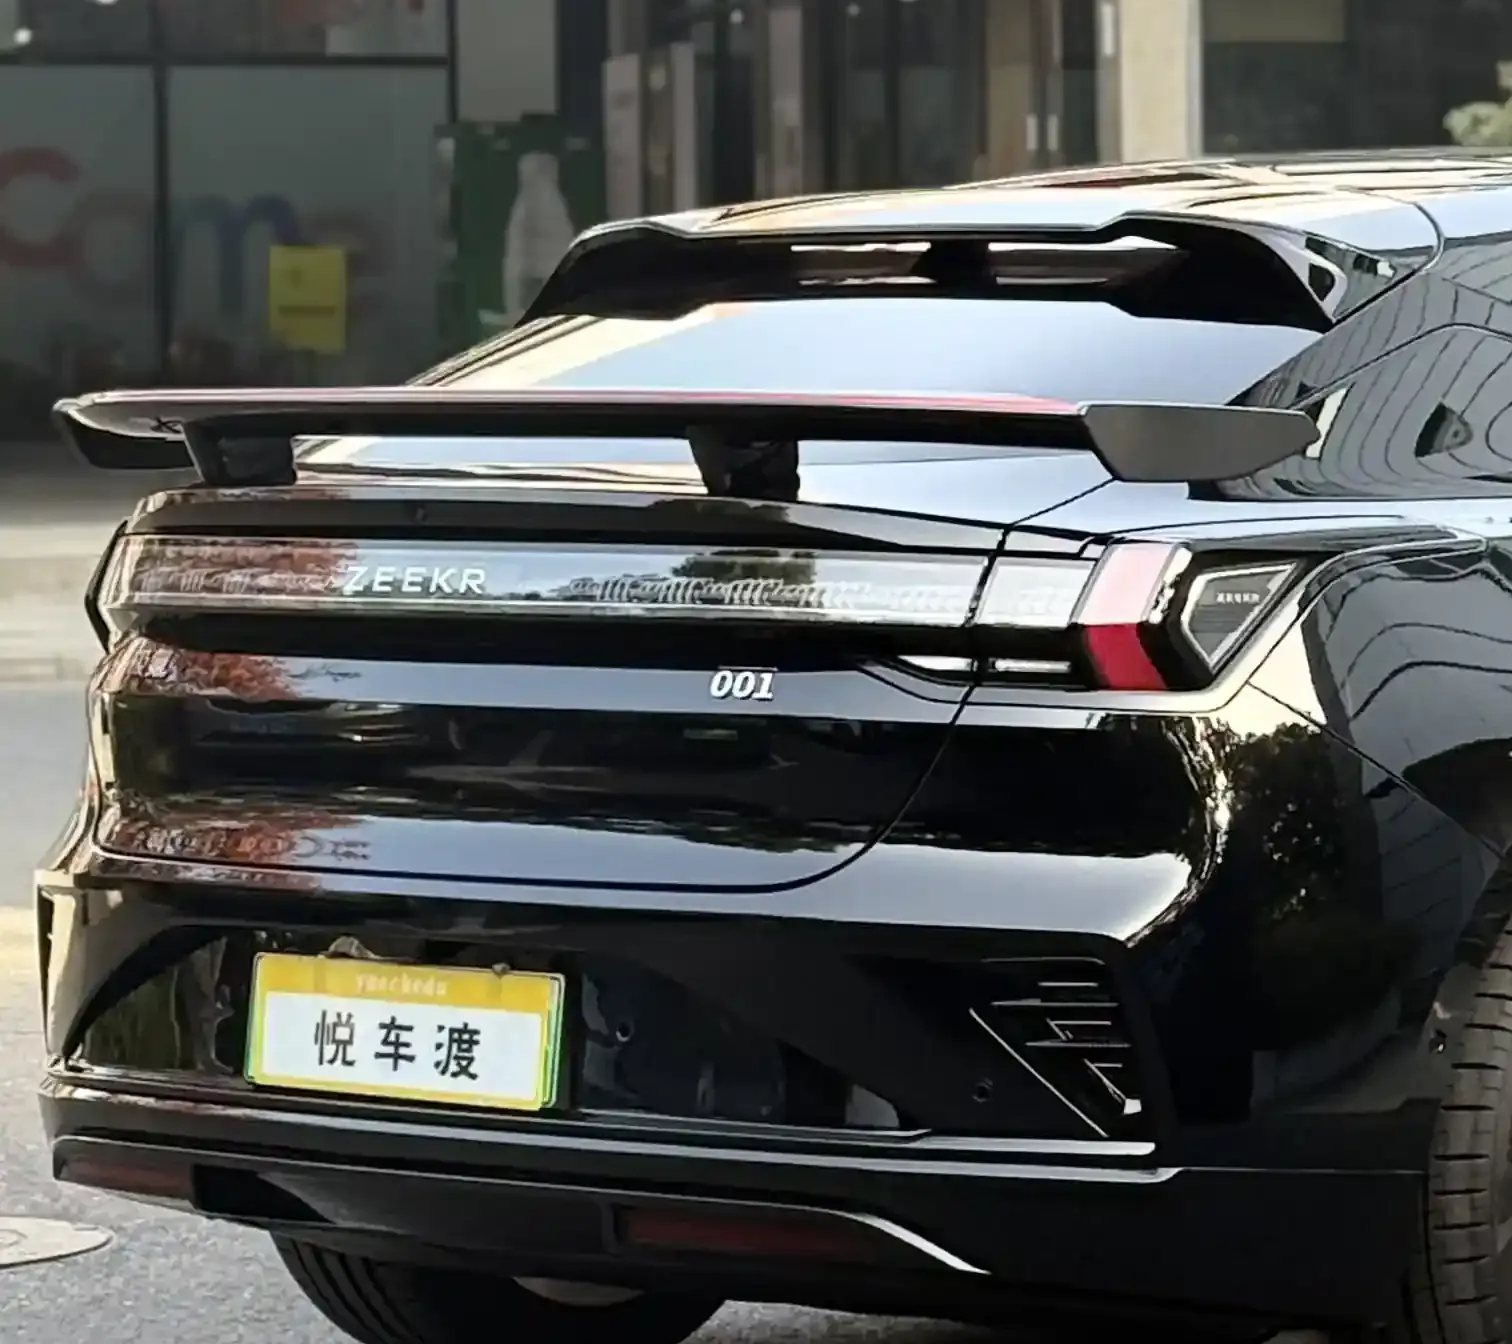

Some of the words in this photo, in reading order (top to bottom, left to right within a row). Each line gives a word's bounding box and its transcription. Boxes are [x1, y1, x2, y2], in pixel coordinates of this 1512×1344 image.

[343, 566, 486, 595] ZEEKR
[710, 670, 773, 699] 001
[314, 1010, 481, 1081] 悦车渡
